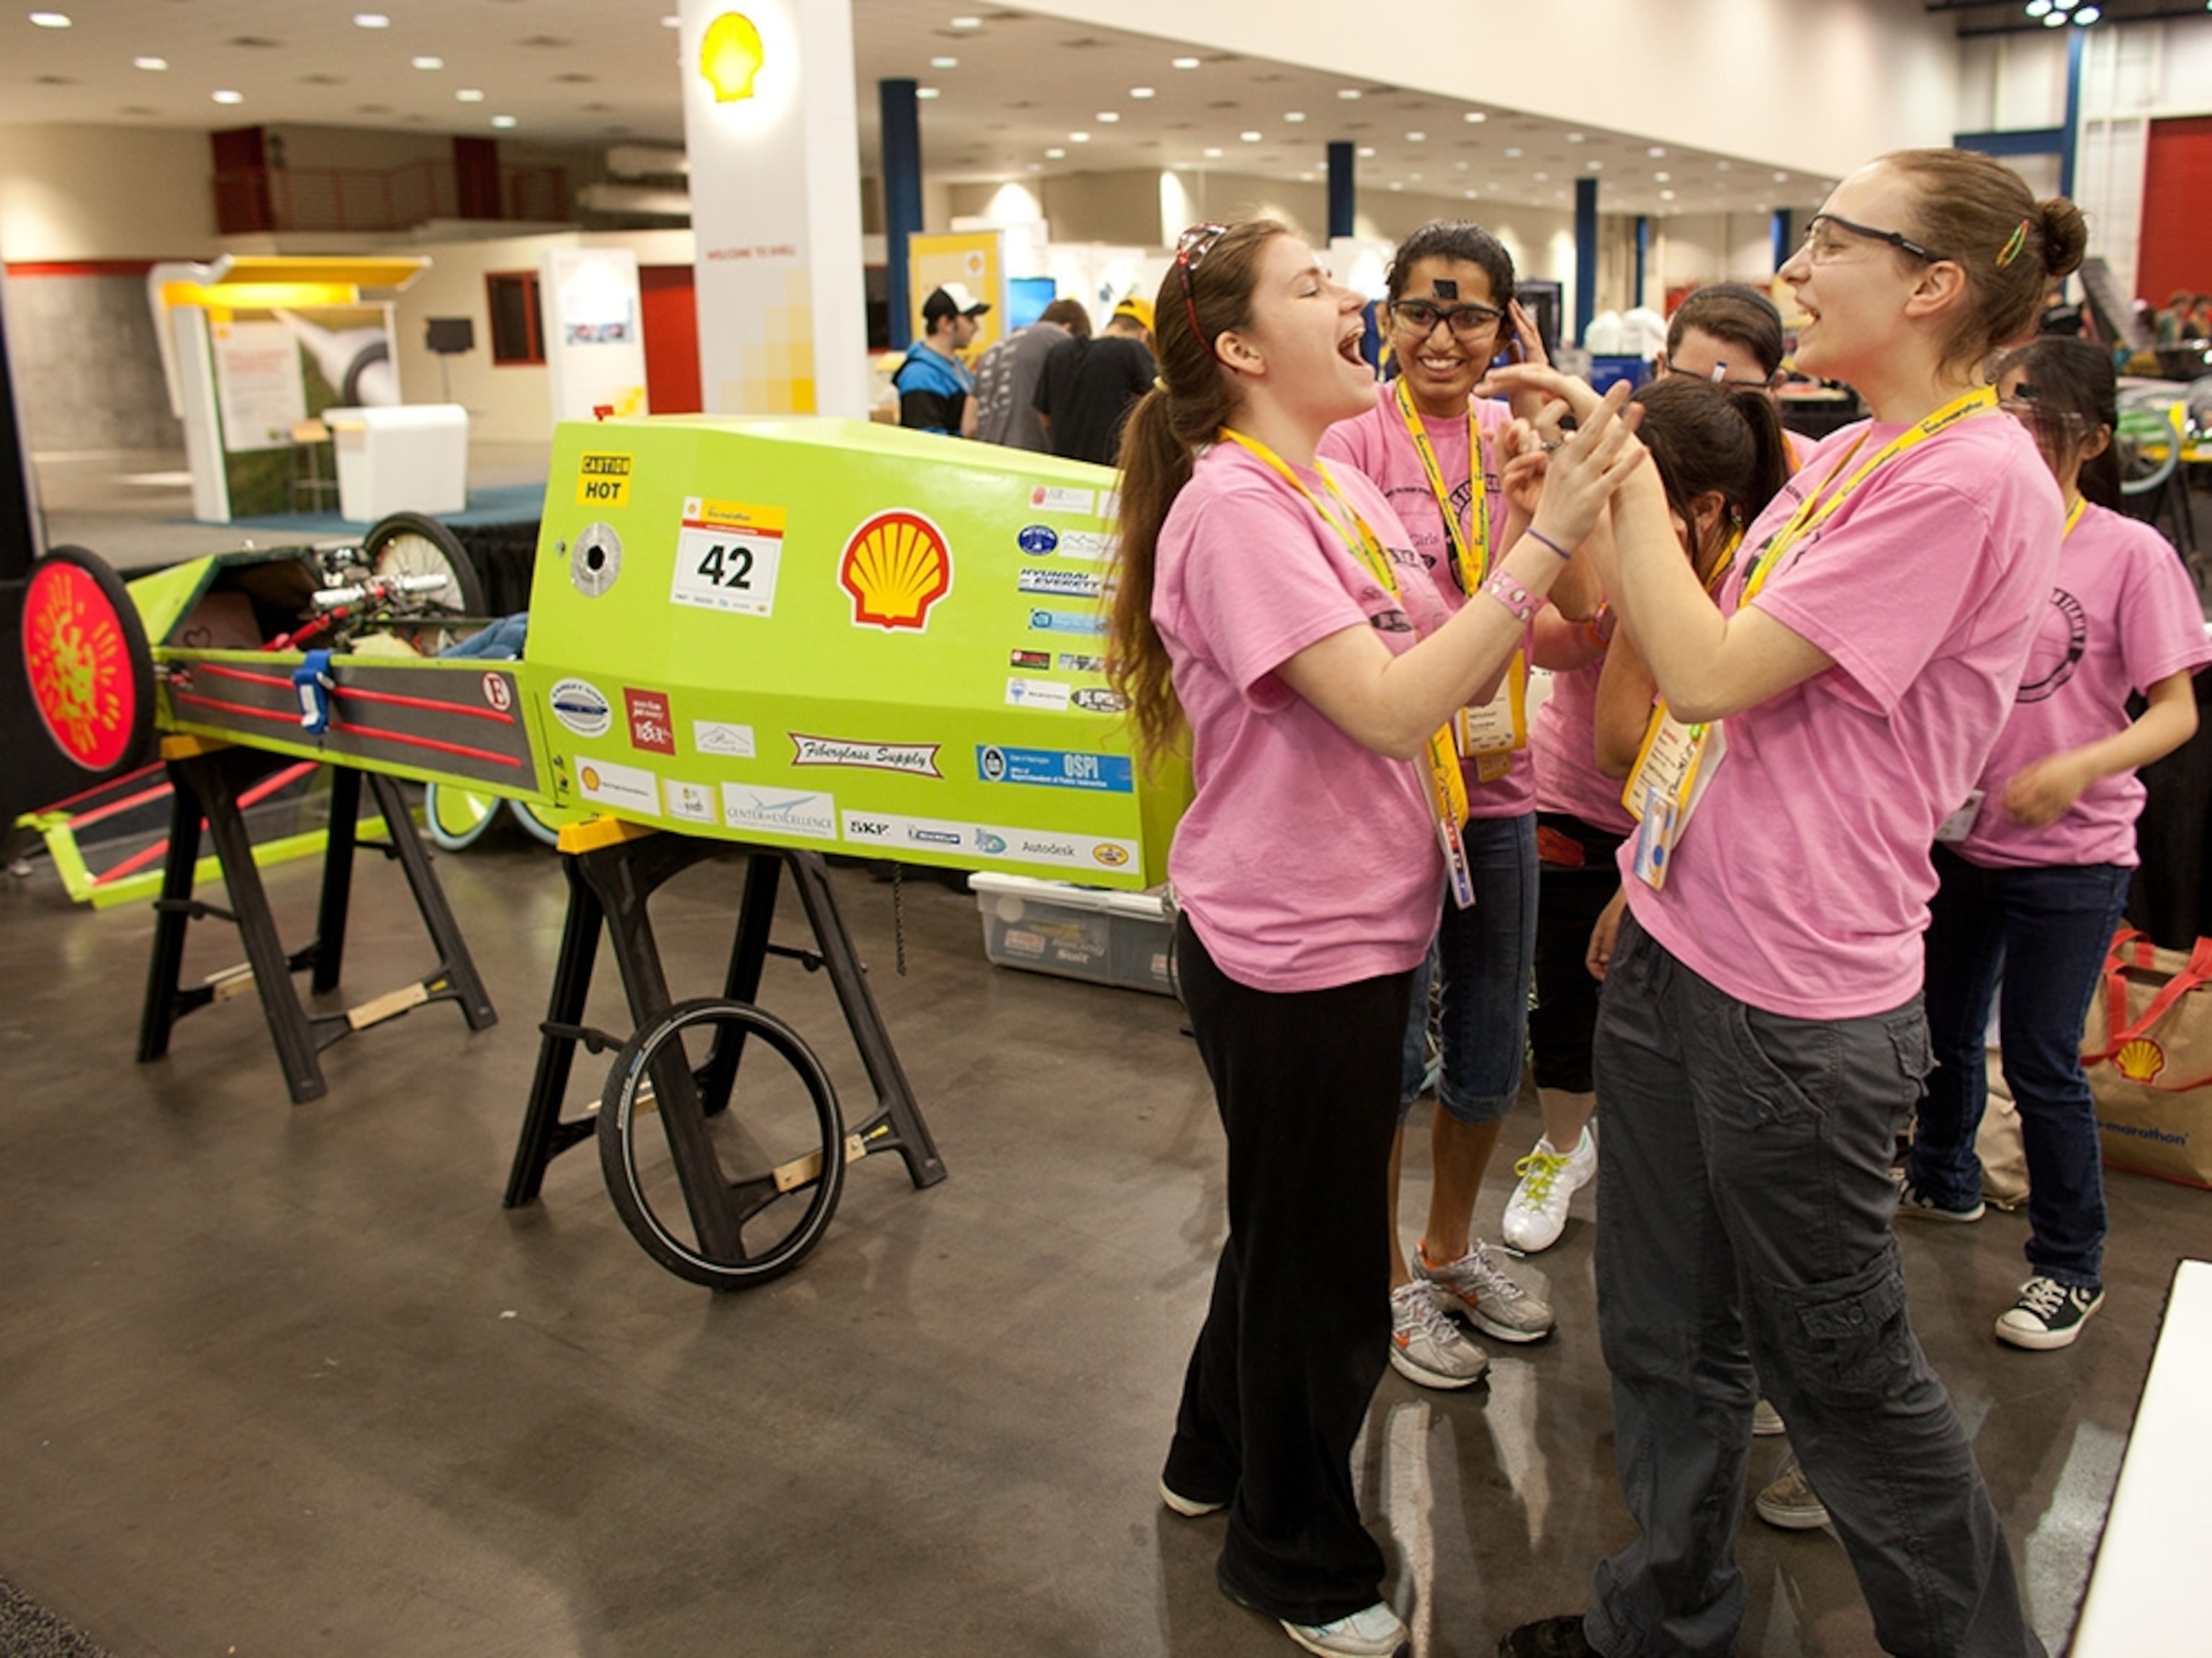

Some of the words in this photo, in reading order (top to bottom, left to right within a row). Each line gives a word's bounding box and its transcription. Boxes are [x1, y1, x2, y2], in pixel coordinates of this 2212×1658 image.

[584, 457, 629, 474] CAUTION
[585, 482, 621, 499] HOT
[696, 545, 754, 590] 42
[1020, 568, 1090, 579] HYUNDAI
[1034, 578, 1101, 589] EVERETT
[804, 742, 870, 762] Fiberglass
[876, 746, 926, 768] Supply
[1063, 753, 1099, 779] OSPI
[727, 807, 765, 820] CENTER
[773, 813, 832, 830] EXCELLENCE
[1022, 841, 1075, 857] Autodesk
[2098, 1121, 2186, 1146] -marathon
